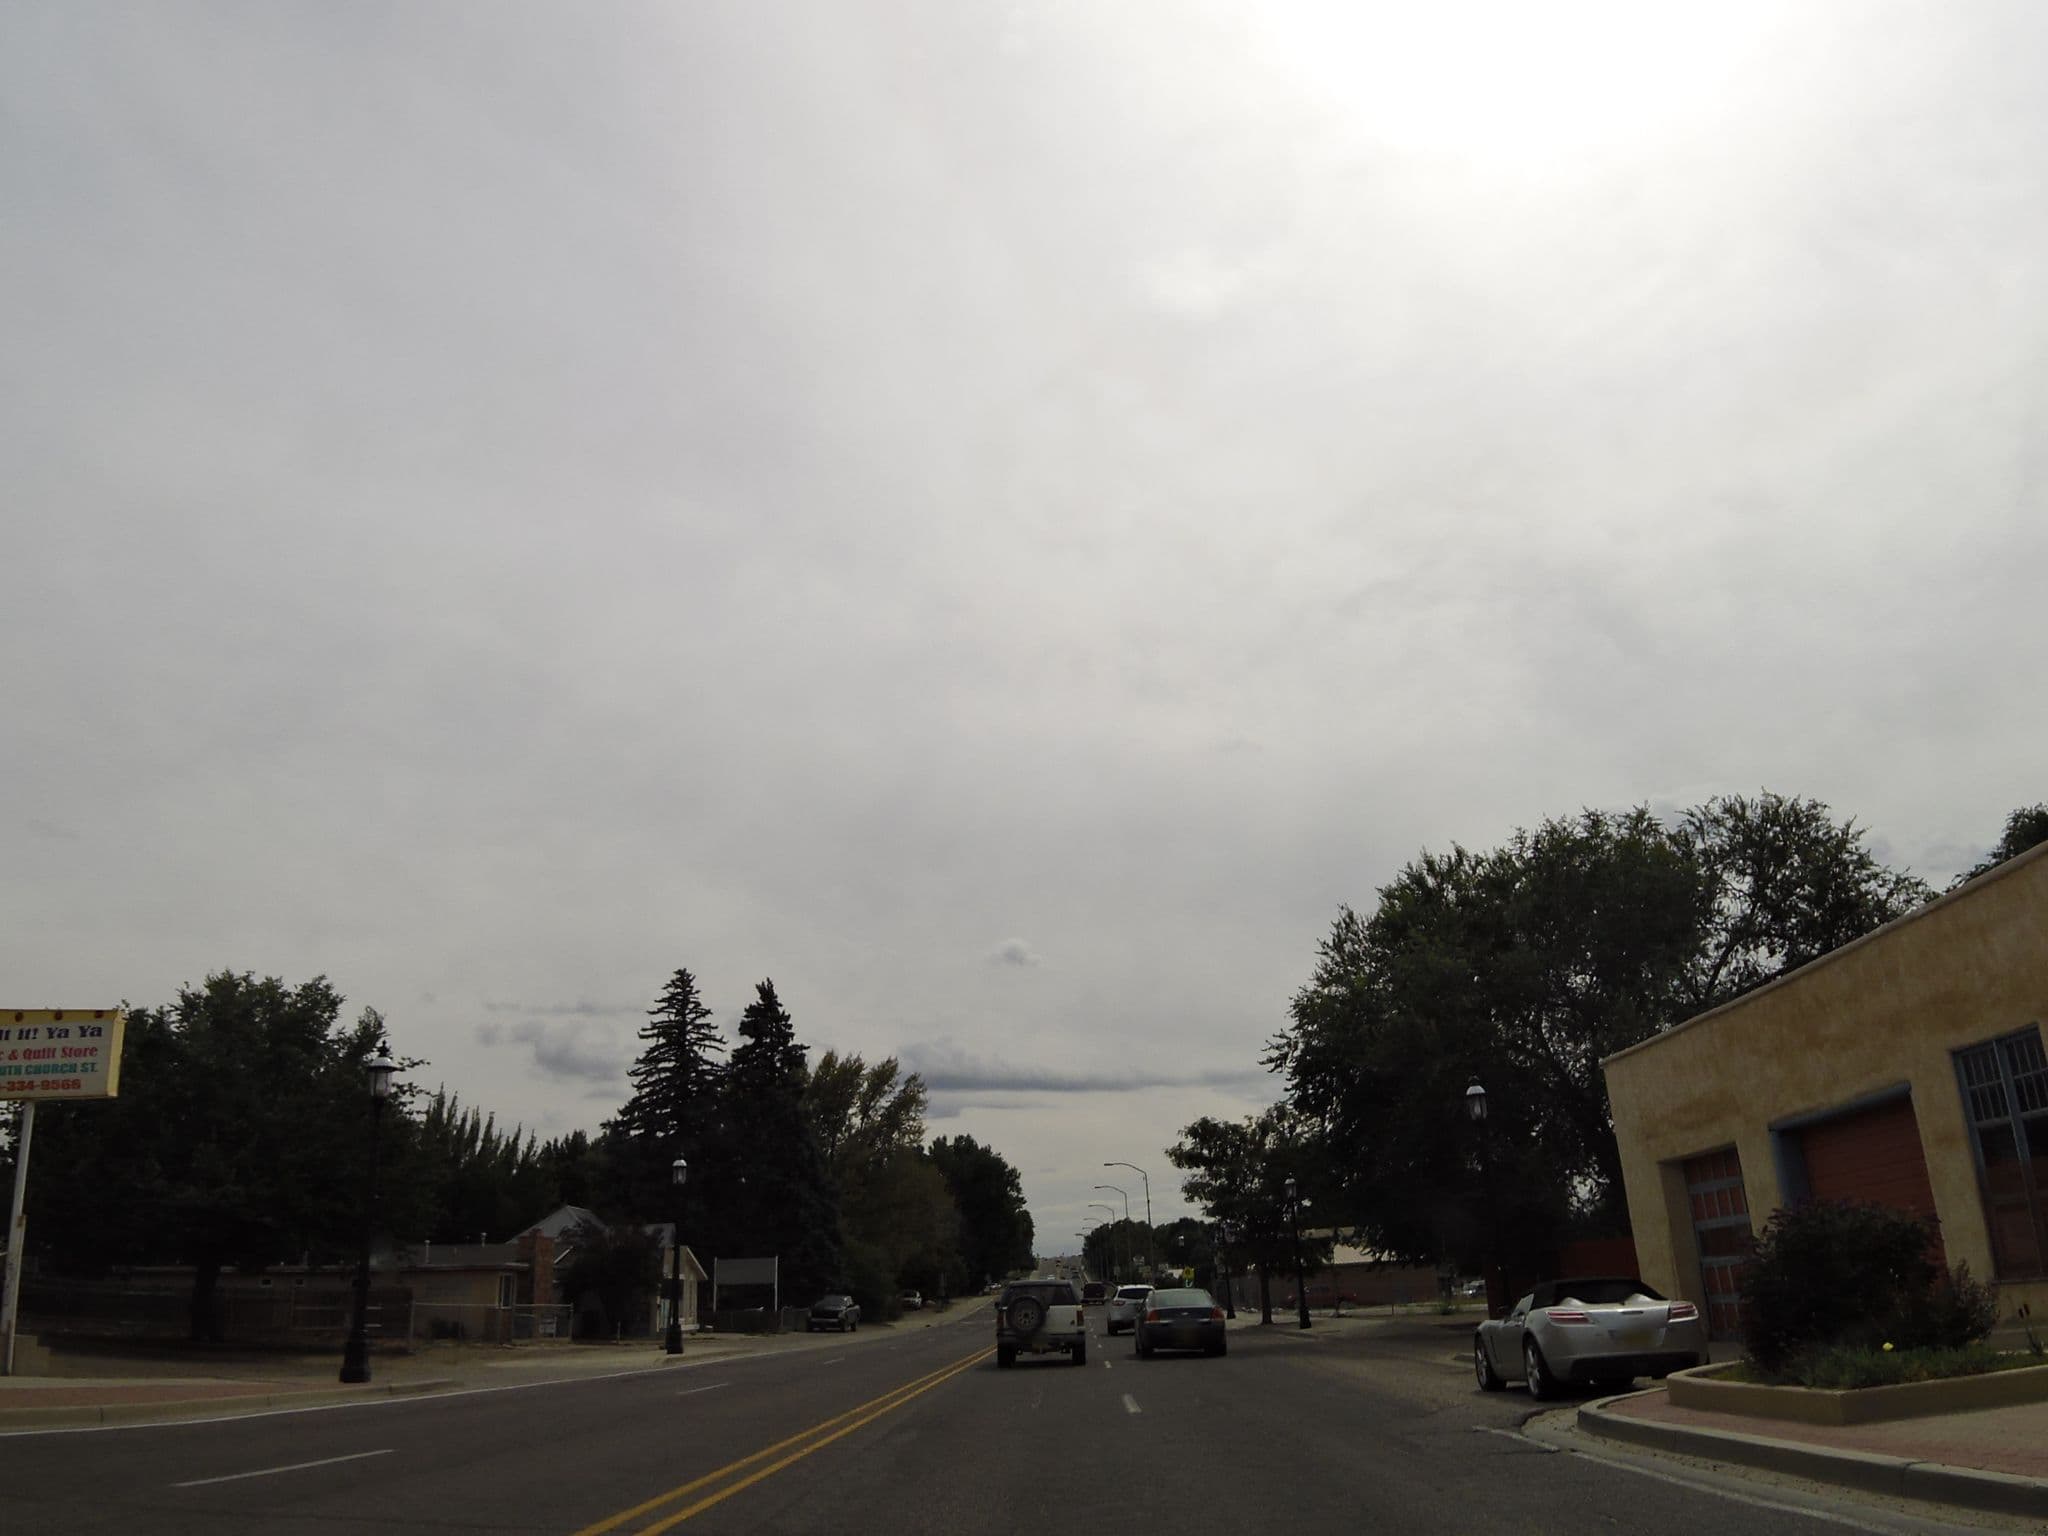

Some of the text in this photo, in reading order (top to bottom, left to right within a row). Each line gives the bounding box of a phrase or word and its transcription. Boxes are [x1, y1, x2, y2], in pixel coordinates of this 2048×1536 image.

[17, 1027, 39, 1040] It!
[46, 1026, 70, 1039] Ya
[78, 1024, 103, 1038] Ya
[8, 1048, 19, 1060] &
[23, 1047, 57, 1060] Quilt
[61, 1045, 98, 1058] Store
[25, 1062, 77, 1075] CHURCH
[80, 1061, 98, 1073] ST.
